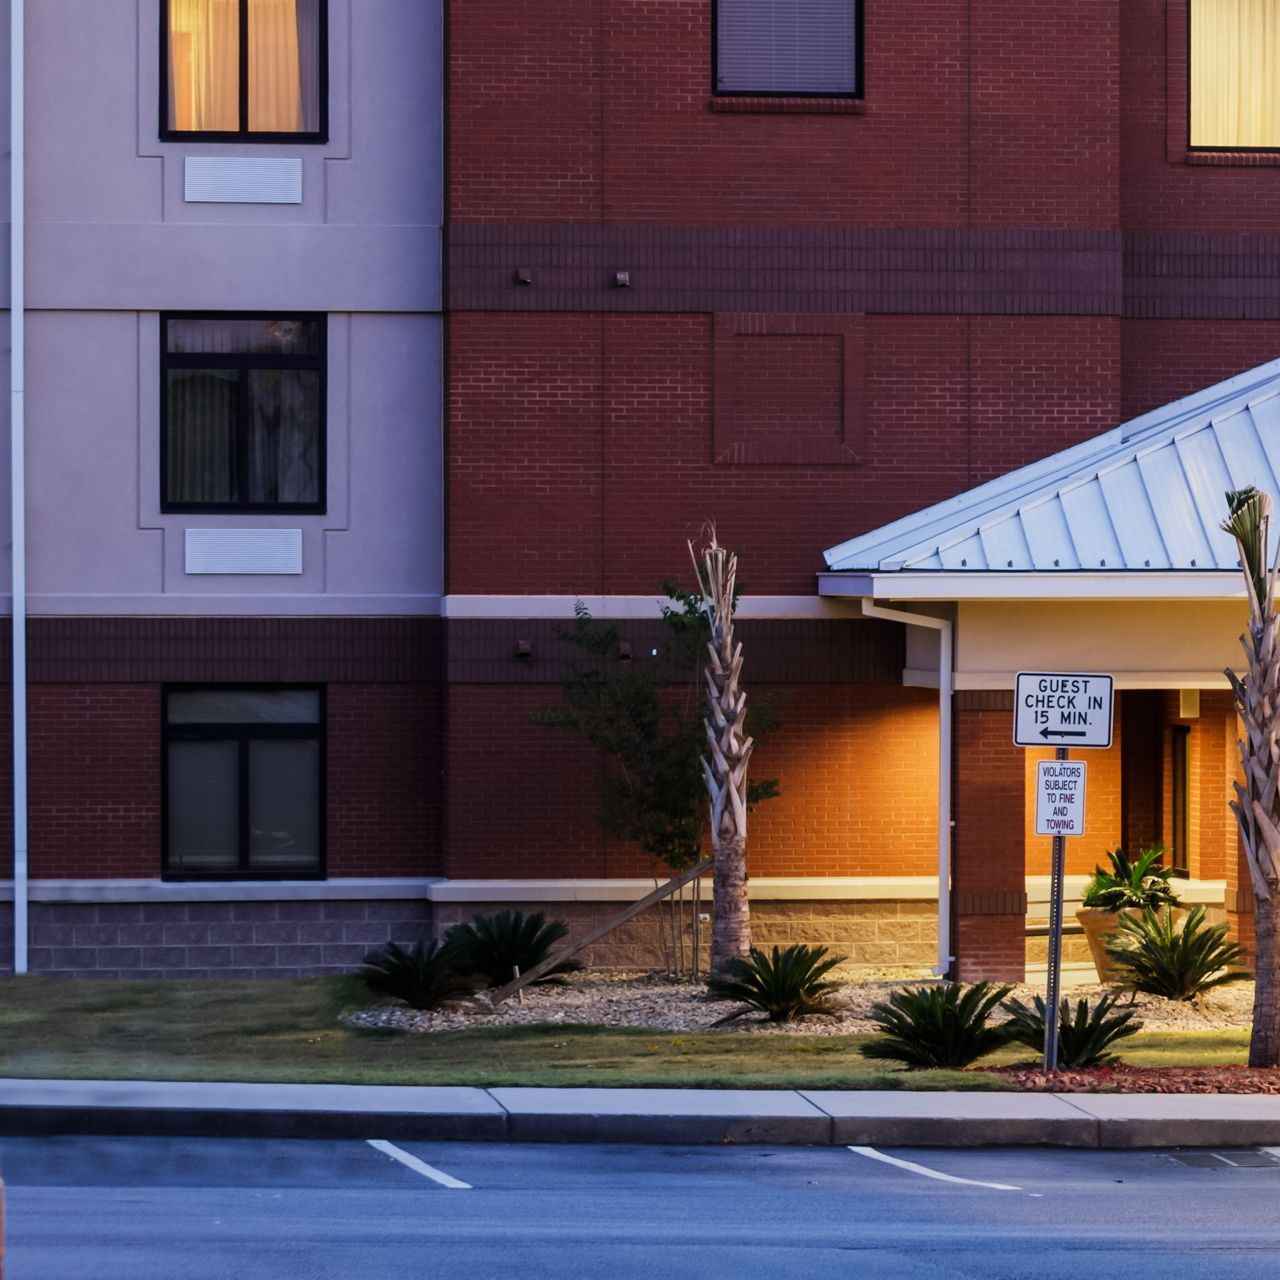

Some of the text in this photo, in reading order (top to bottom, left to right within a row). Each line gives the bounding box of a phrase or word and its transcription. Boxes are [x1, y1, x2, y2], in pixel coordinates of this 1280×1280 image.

[1038, 679, 1090, 694] GUEST
[1025, 694, 1103, 710] CHECK IN
[1034, 710, 1093, 726] 15 MIN.
[1042, 767, 1081, 778] VIOLATORS
[1044, 780, 1078, 791] SUBJECT
[1047, 793, 1075, 804] TO FINE
[1052, 806, 1068, 817] AND
[1046, 819, 1074, 830] TOWING
